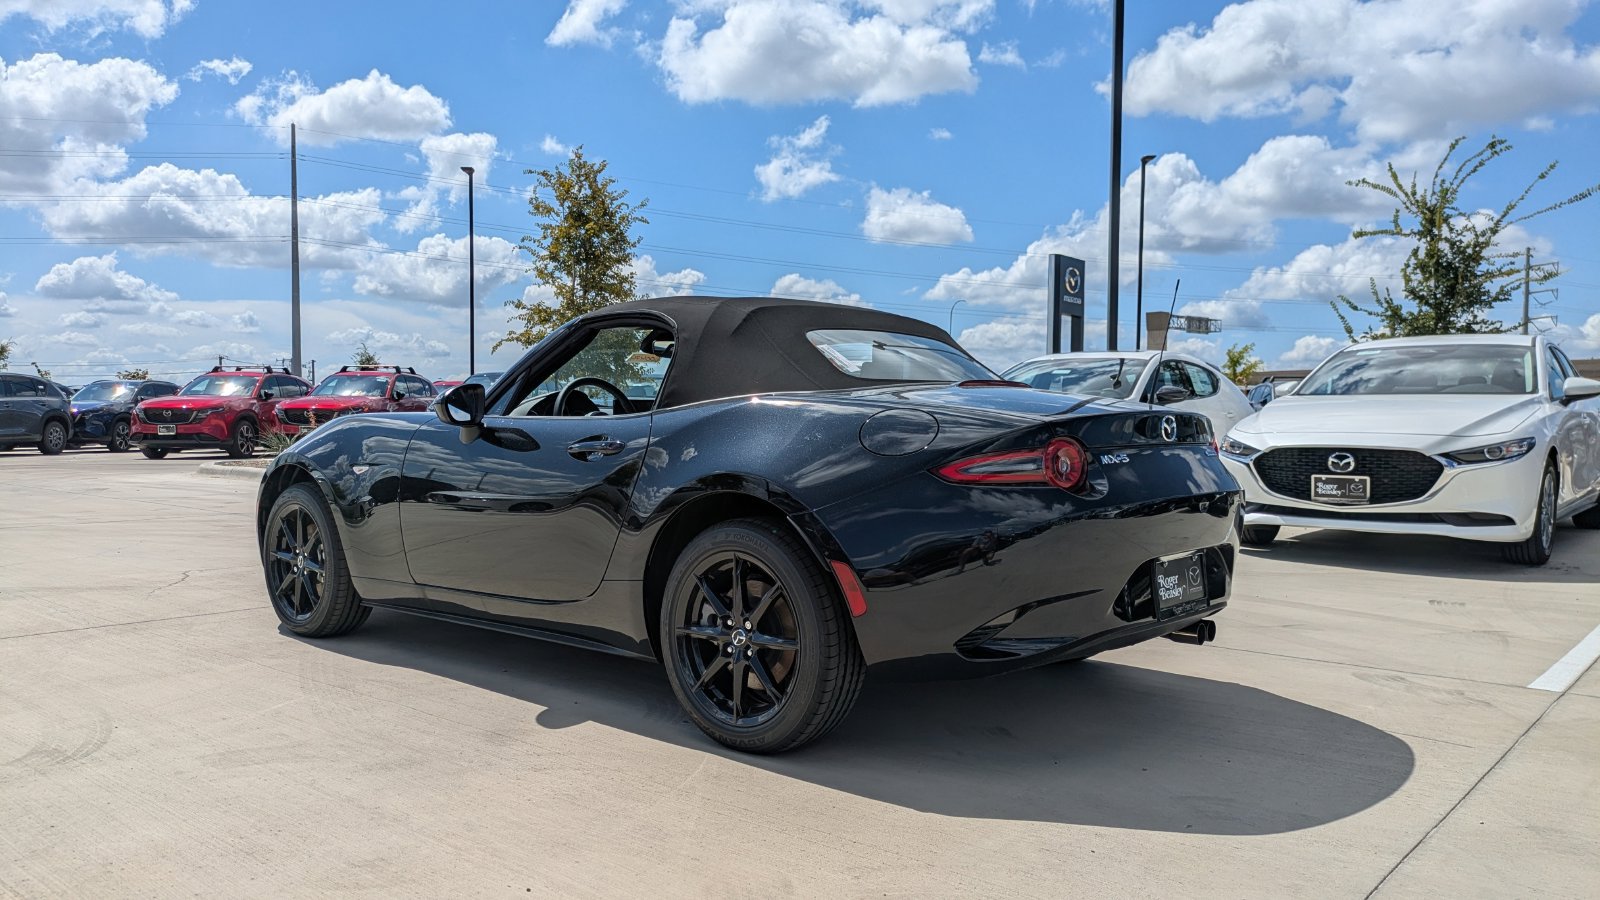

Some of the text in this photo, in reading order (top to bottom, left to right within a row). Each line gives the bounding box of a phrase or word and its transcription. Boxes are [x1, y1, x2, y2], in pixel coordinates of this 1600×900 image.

[1100, 454, 1130, 465] MX-5
[733, 533, 769, 552] YOKOHAMA
[1157, 574, 1179, 589] Roger
[1159, 585, 1186, 600] Beasley
